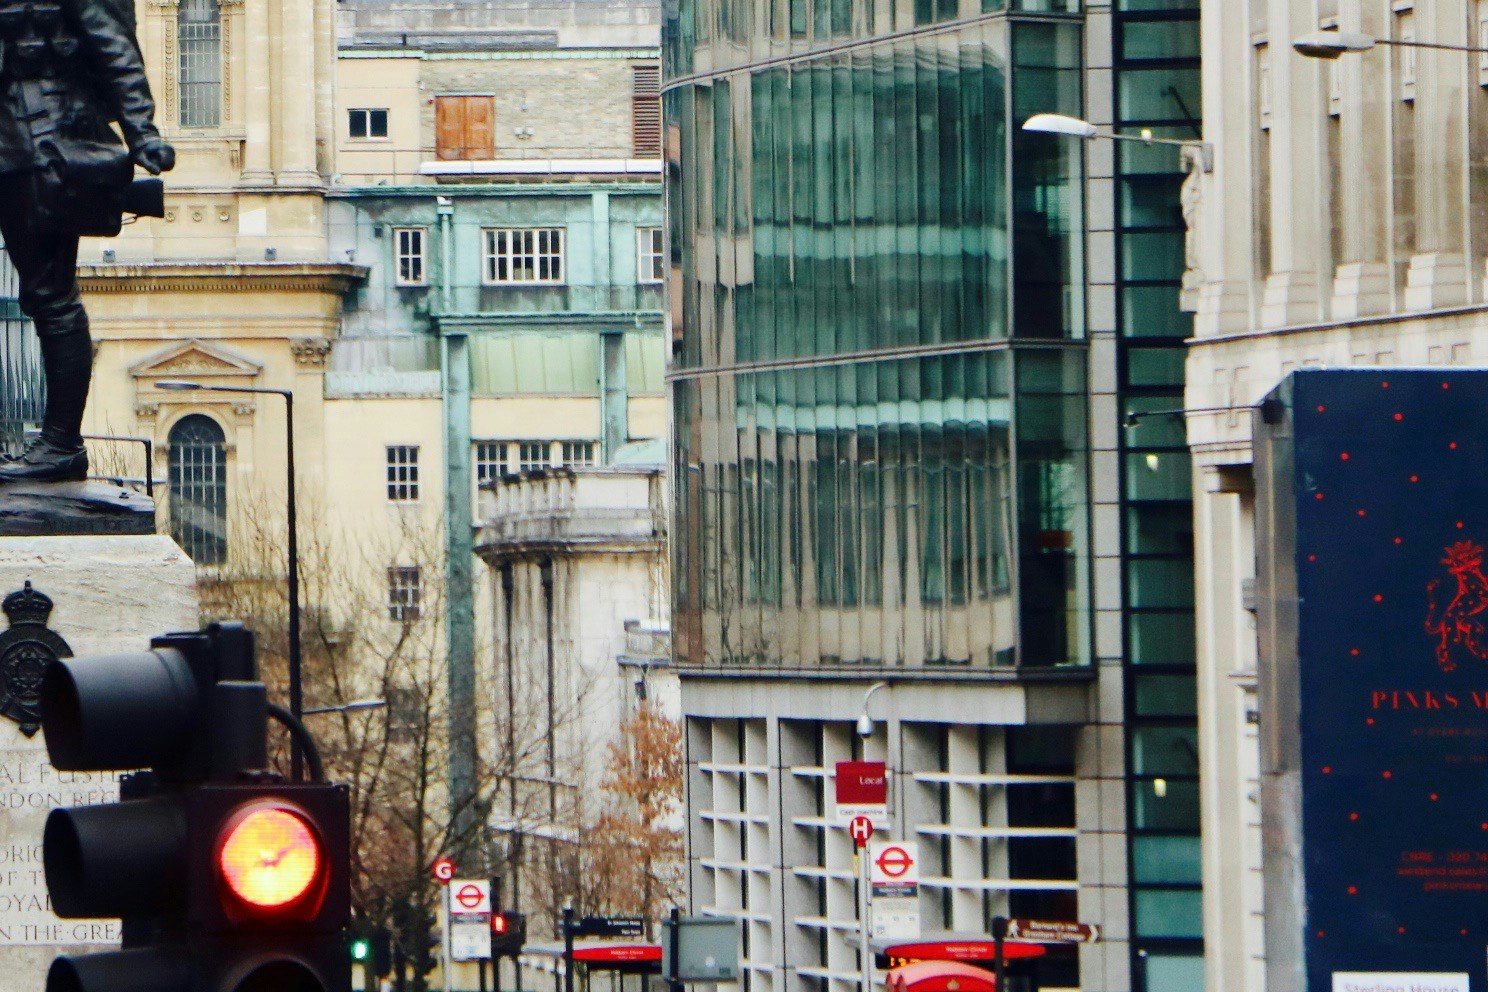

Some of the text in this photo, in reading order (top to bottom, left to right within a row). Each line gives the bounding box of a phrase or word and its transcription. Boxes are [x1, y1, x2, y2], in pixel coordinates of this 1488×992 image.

[1372, 690, 1459, 709] PINKS
[39, 763, 124, 784] FUSIL
[859, 776, 884, 785] Local
[853, 818, 869, 840] H
[435, 862, 453, 881] G
[20, 924, 63, 941] THE
